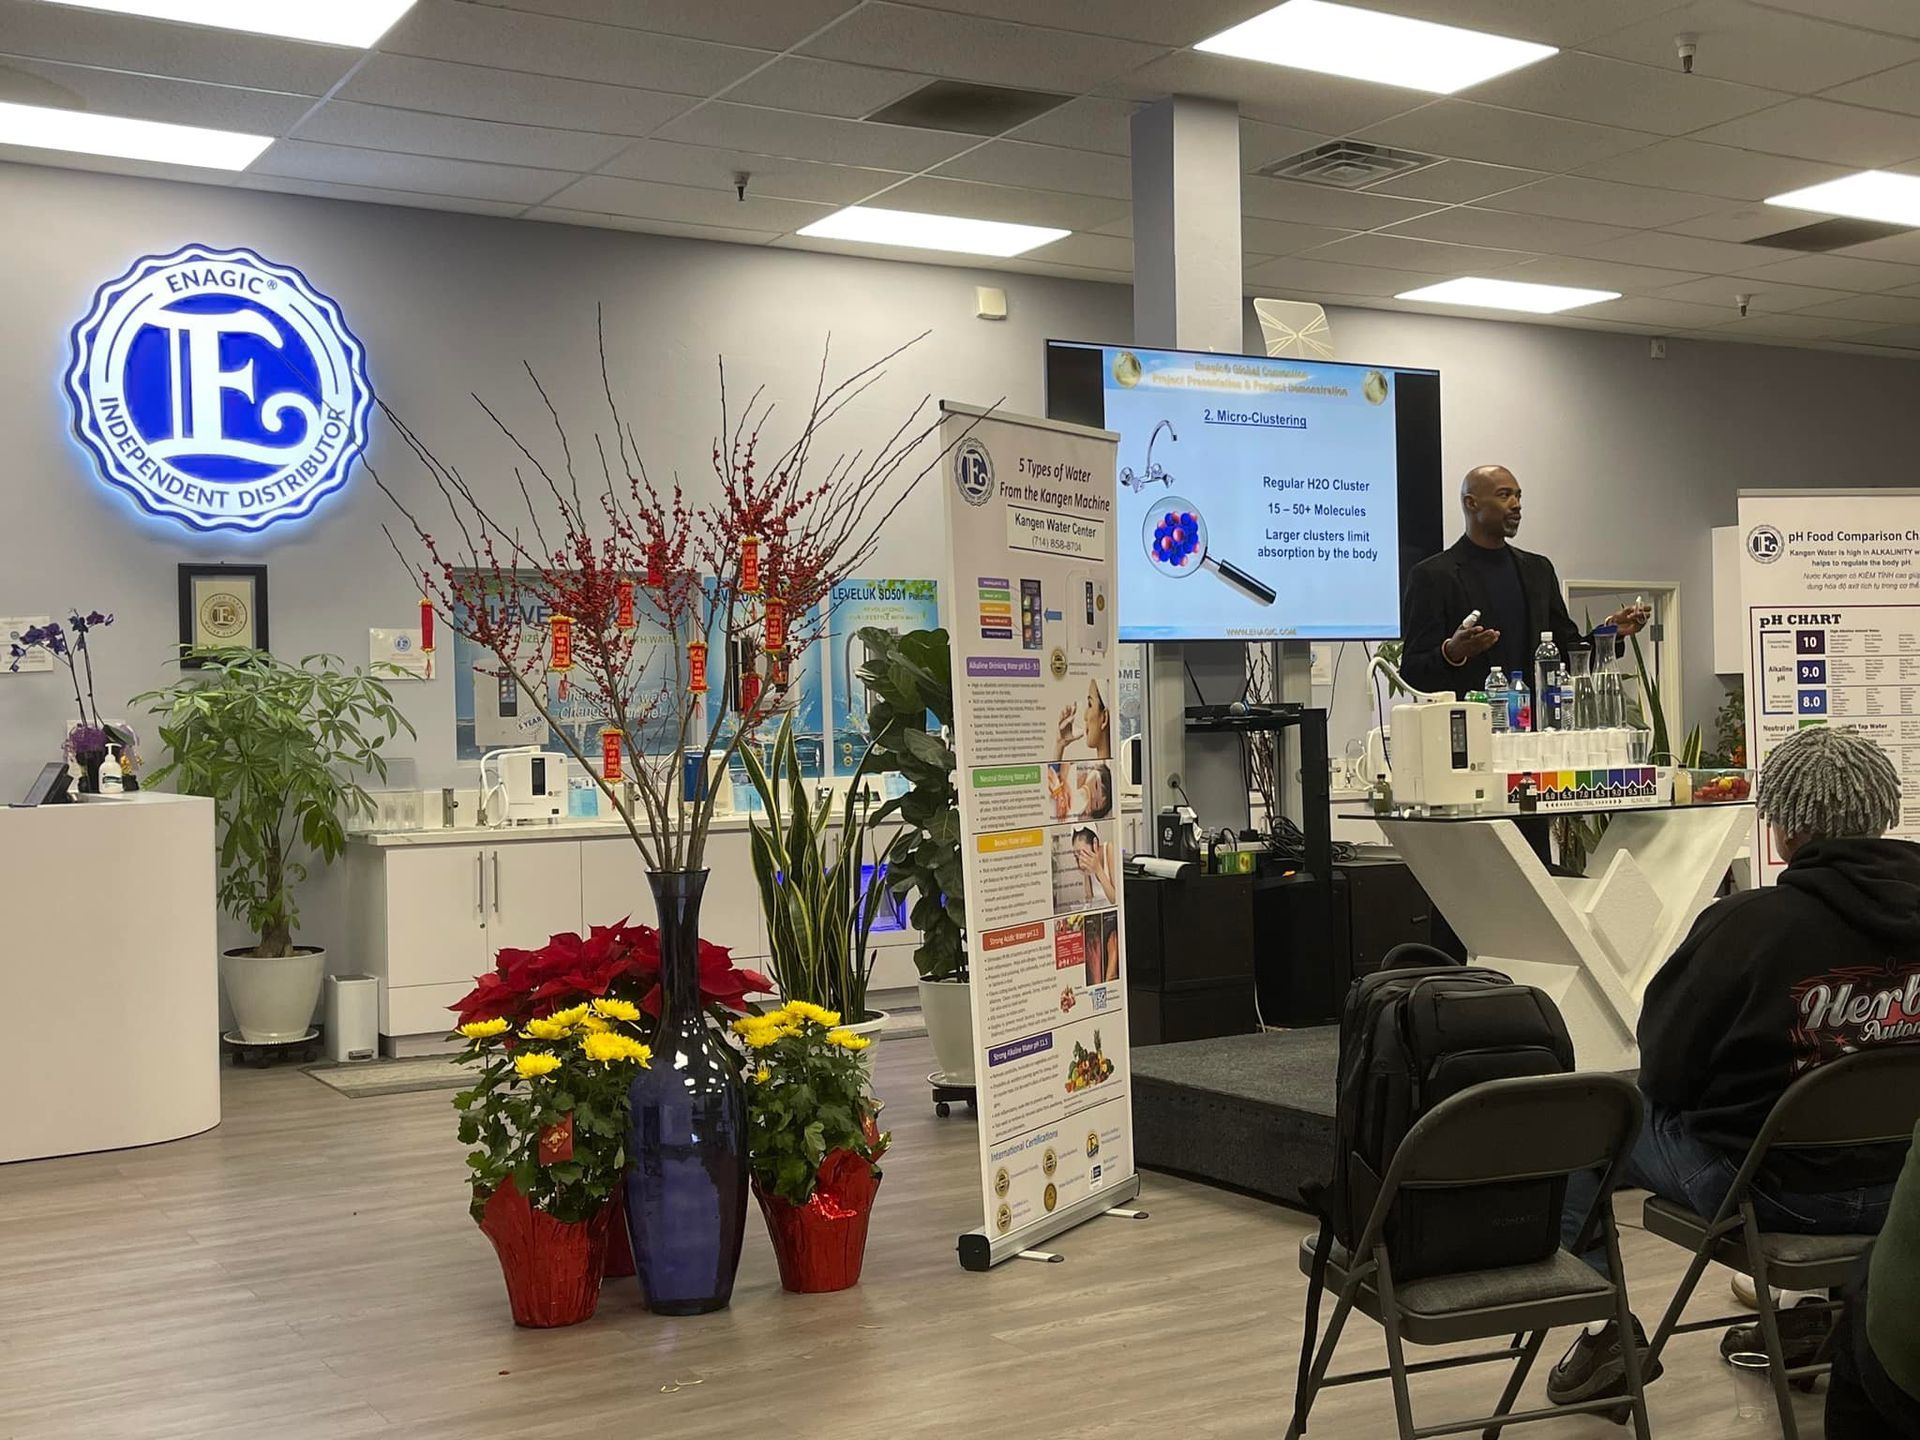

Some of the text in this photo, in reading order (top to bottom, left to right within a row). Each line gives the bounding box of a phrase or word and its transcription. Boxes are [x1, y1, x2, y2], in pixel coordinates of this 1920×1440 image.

[1288, 383, 1348, 397] Demonstration
[1204, 408, 1307, 428] 2. Micro-Clustering
[99, 397, 345, 508] INDEPENDENT DISTRIBUTOR
[1018, 458, 1091, 483] 5 Types of Water
[1263, 476, 1370, 491] Regular H2O Cluster
[1000, 481, 1110, 512] From the Kangen Machine
[1268, 502, 1280, 514] 15
[1292, 503, 1311, 515] 50+
[1314, 504, 1366, 517] Molecules
[1015, 512, 1096, 538] Kangen Water Center
[1031, 536, 1049, 548] (714)
[1265, 528, 1370, 543] Larger clusters limit
[1788, 530, 1919, 543] pH Food Comparison Ch
[1257, 546, 1378, 562] absorption by the body
[1789, 549, 1816, 557] Kangen
[1846, 549, 1861, 557] high
[833, 588, 876, 600] LEVELUK
[878, 588, 906, 600] SD501
[1760, 614, 1841, 628] pH CHART
[1803, 636, 1817, 648] 10
[1768, 665, 1793, 673] Alkaline
[1802, 666, 1819, 678] 9.0
[1803, 696, 1821, 708] 8.0
[1763, 724, 1795, 734] Neutral pH
[1545, 791, 1556, 801] 6.0
[1562, 790, 1573, 800] 6.5
[1579, 789, 1590, 799] 7.0
[1612, 788, 1622, 797] 9.0
[1627, 786, 1638, 796] 9.5
[1642, 785, 1656, 796] 11.5
[1801, 973, 1920, 1030] Herb
[990, 1129, 1058, 1162] International Certifications
